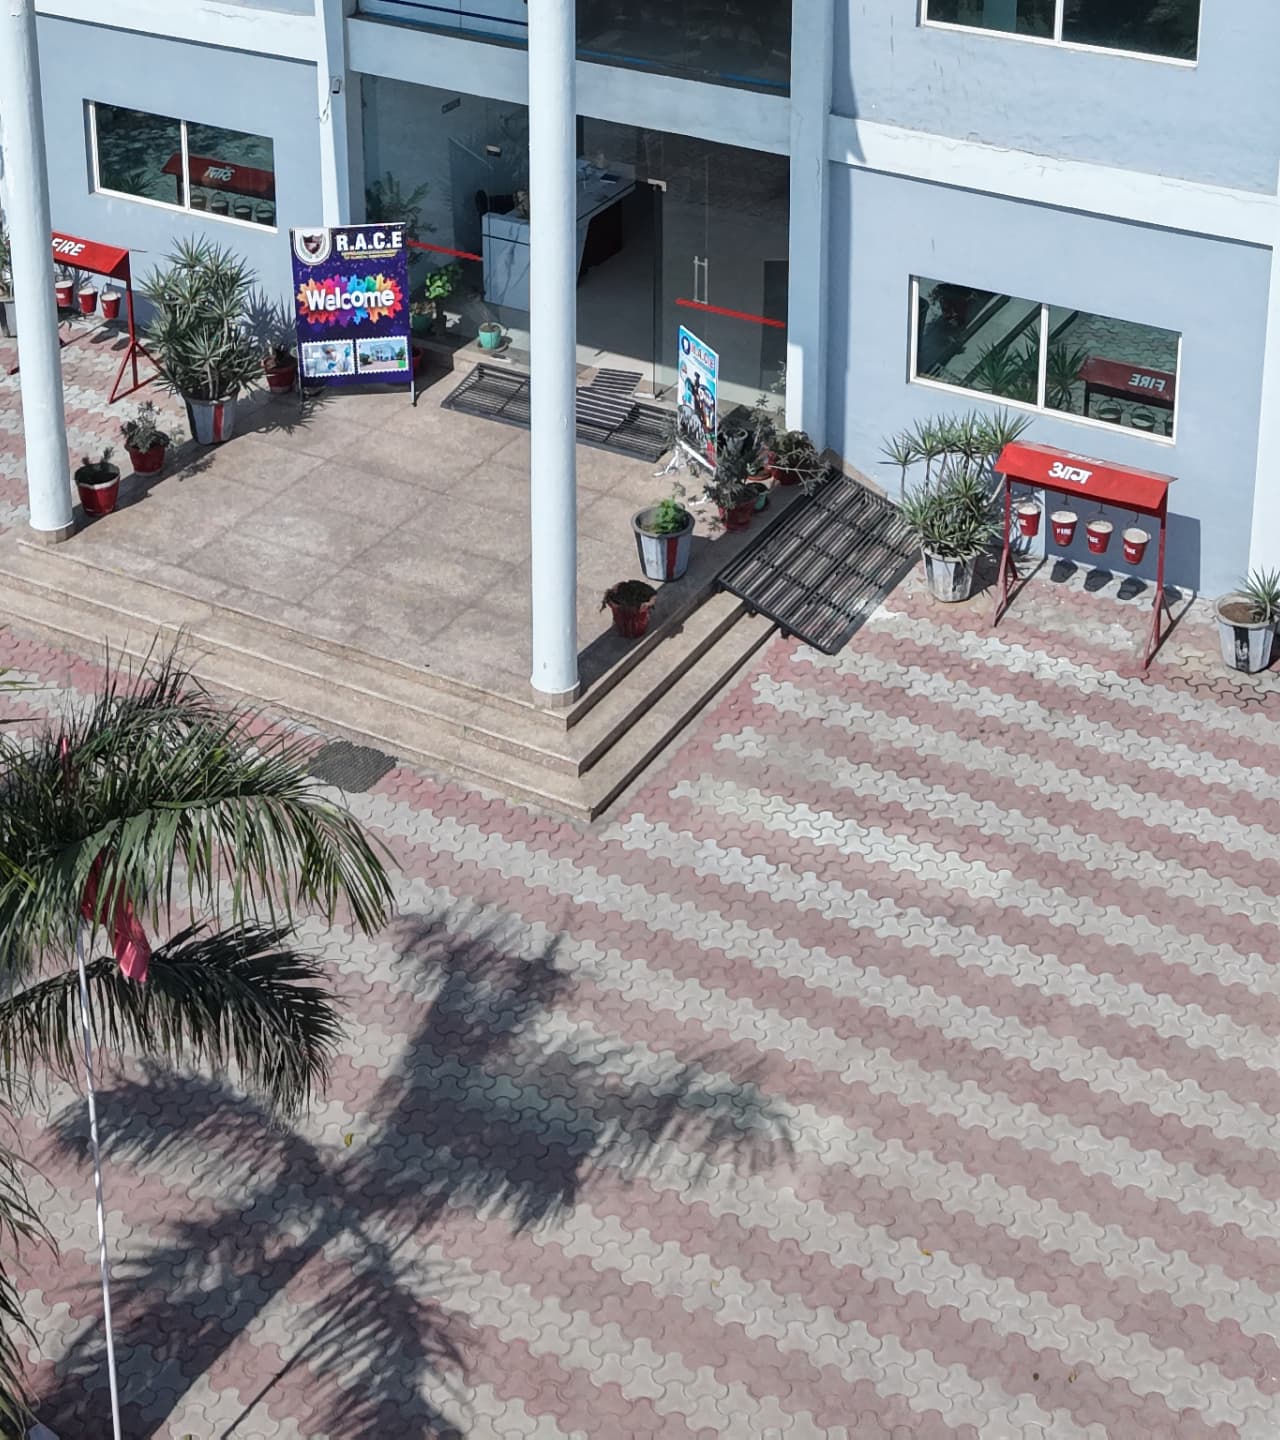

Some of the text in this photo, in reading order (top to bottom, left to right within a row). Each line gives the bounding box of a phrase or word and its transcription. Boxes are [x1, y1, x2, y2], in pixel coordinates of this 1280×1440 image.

[336, 232, 402, 251] R.A.C.E
[306, 287, 395, 311] Welcome
[1048, 462, 1093, 485] आग
